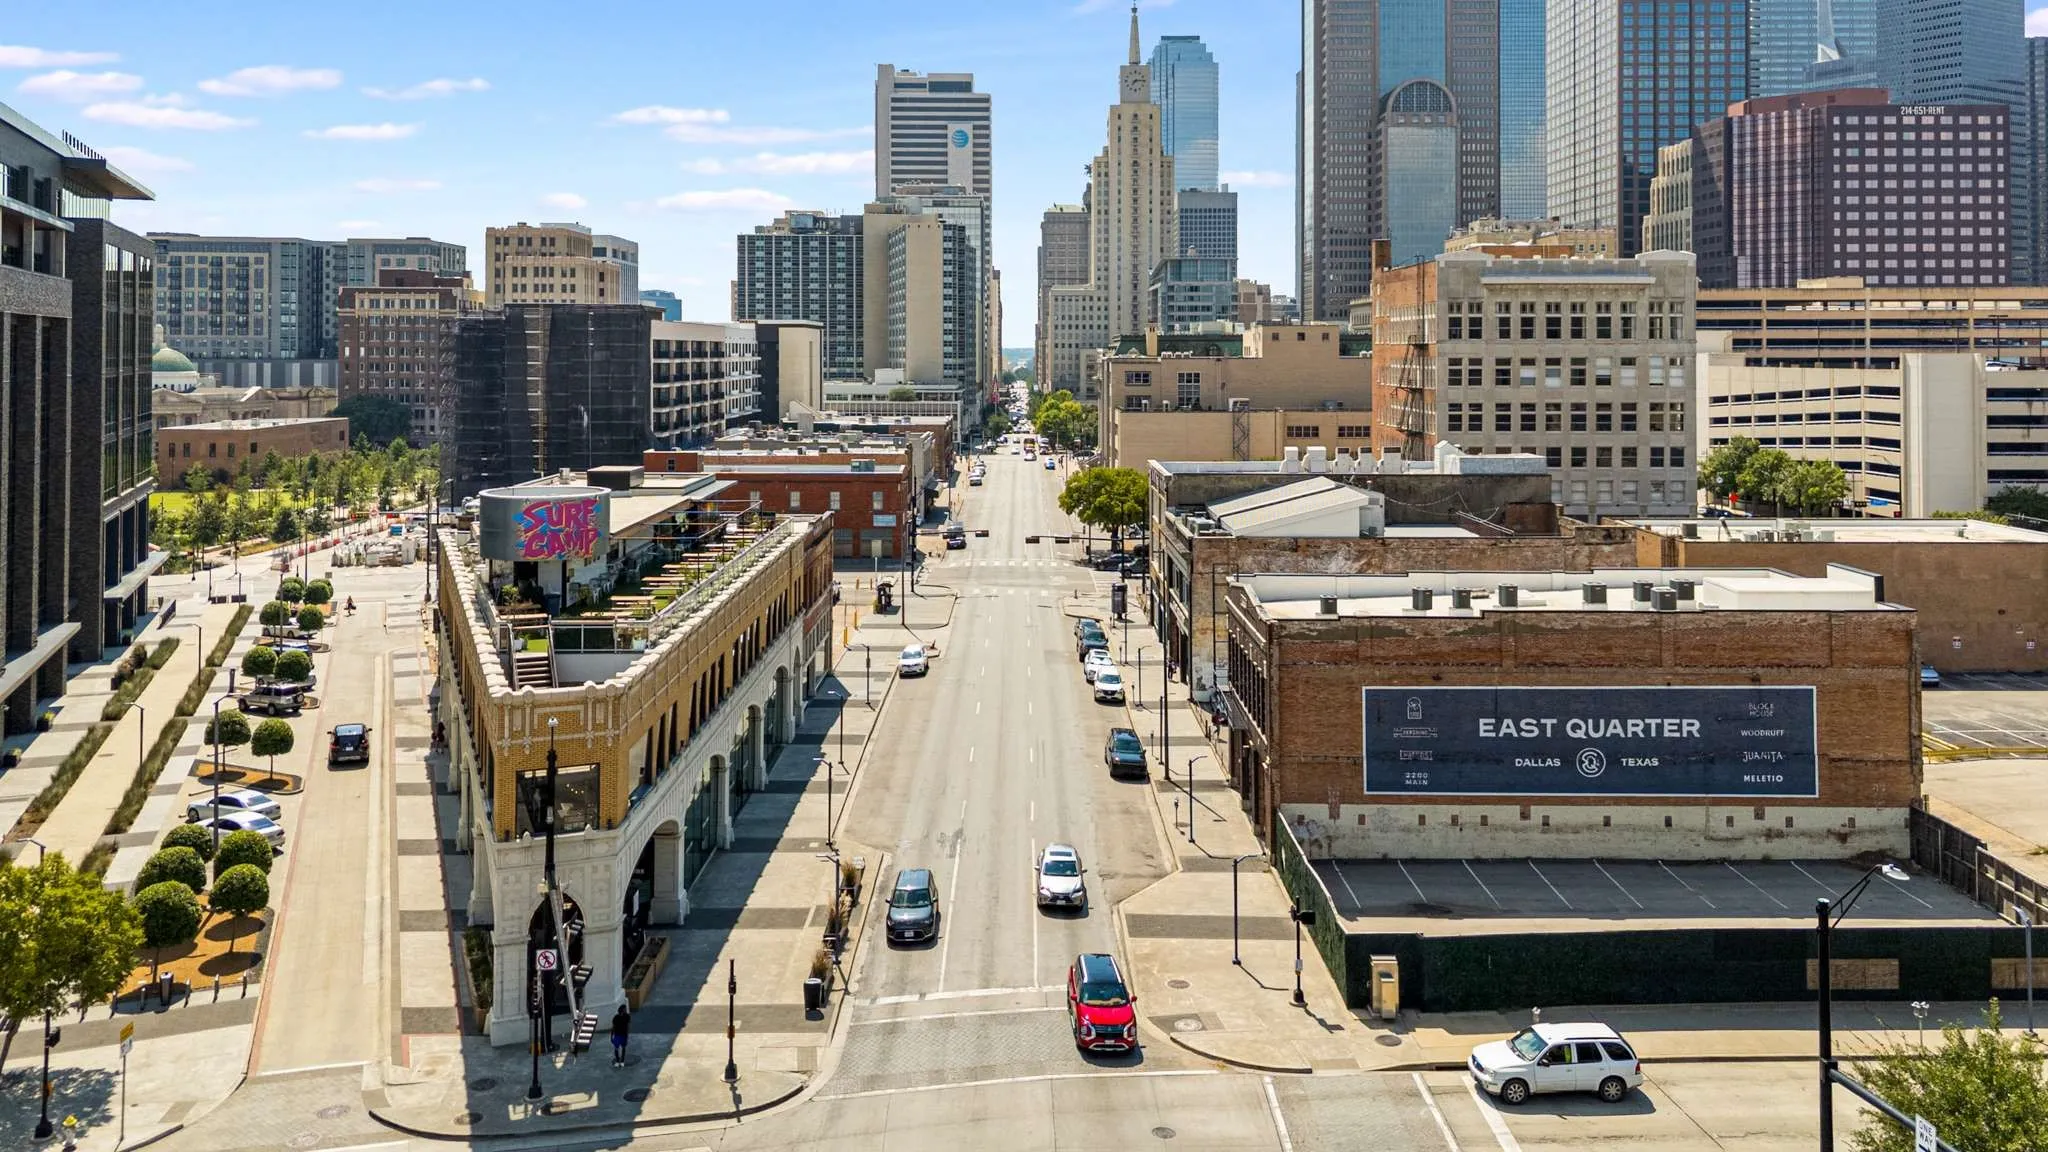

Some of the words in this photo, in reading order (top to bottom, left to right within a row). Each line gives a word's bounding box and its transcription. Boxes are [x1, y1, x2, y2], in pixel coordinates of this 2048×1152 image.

[1900, 106, 1945, 115] 214-651-RENT
[523, 499, 599, 535] SURF
[523, 527, 599, 560] CAMP
[1479, 718, 1557, 737] EAST
[1565, 718, 1701, 739] QUARTER
[1740, 729, 1784, 737] WOODRUFF
[1515, 758, 1561, 767] DALLAS
[1620, 758, 1660, 767] TEXAS
[1742, 751, 1783, 763] JUANITA
[1743, 774, 1784, 782] MELETIO
[1919, 1120, 1933, 1136] ONE
[1920, 1132, 1933, 1147] WAY
